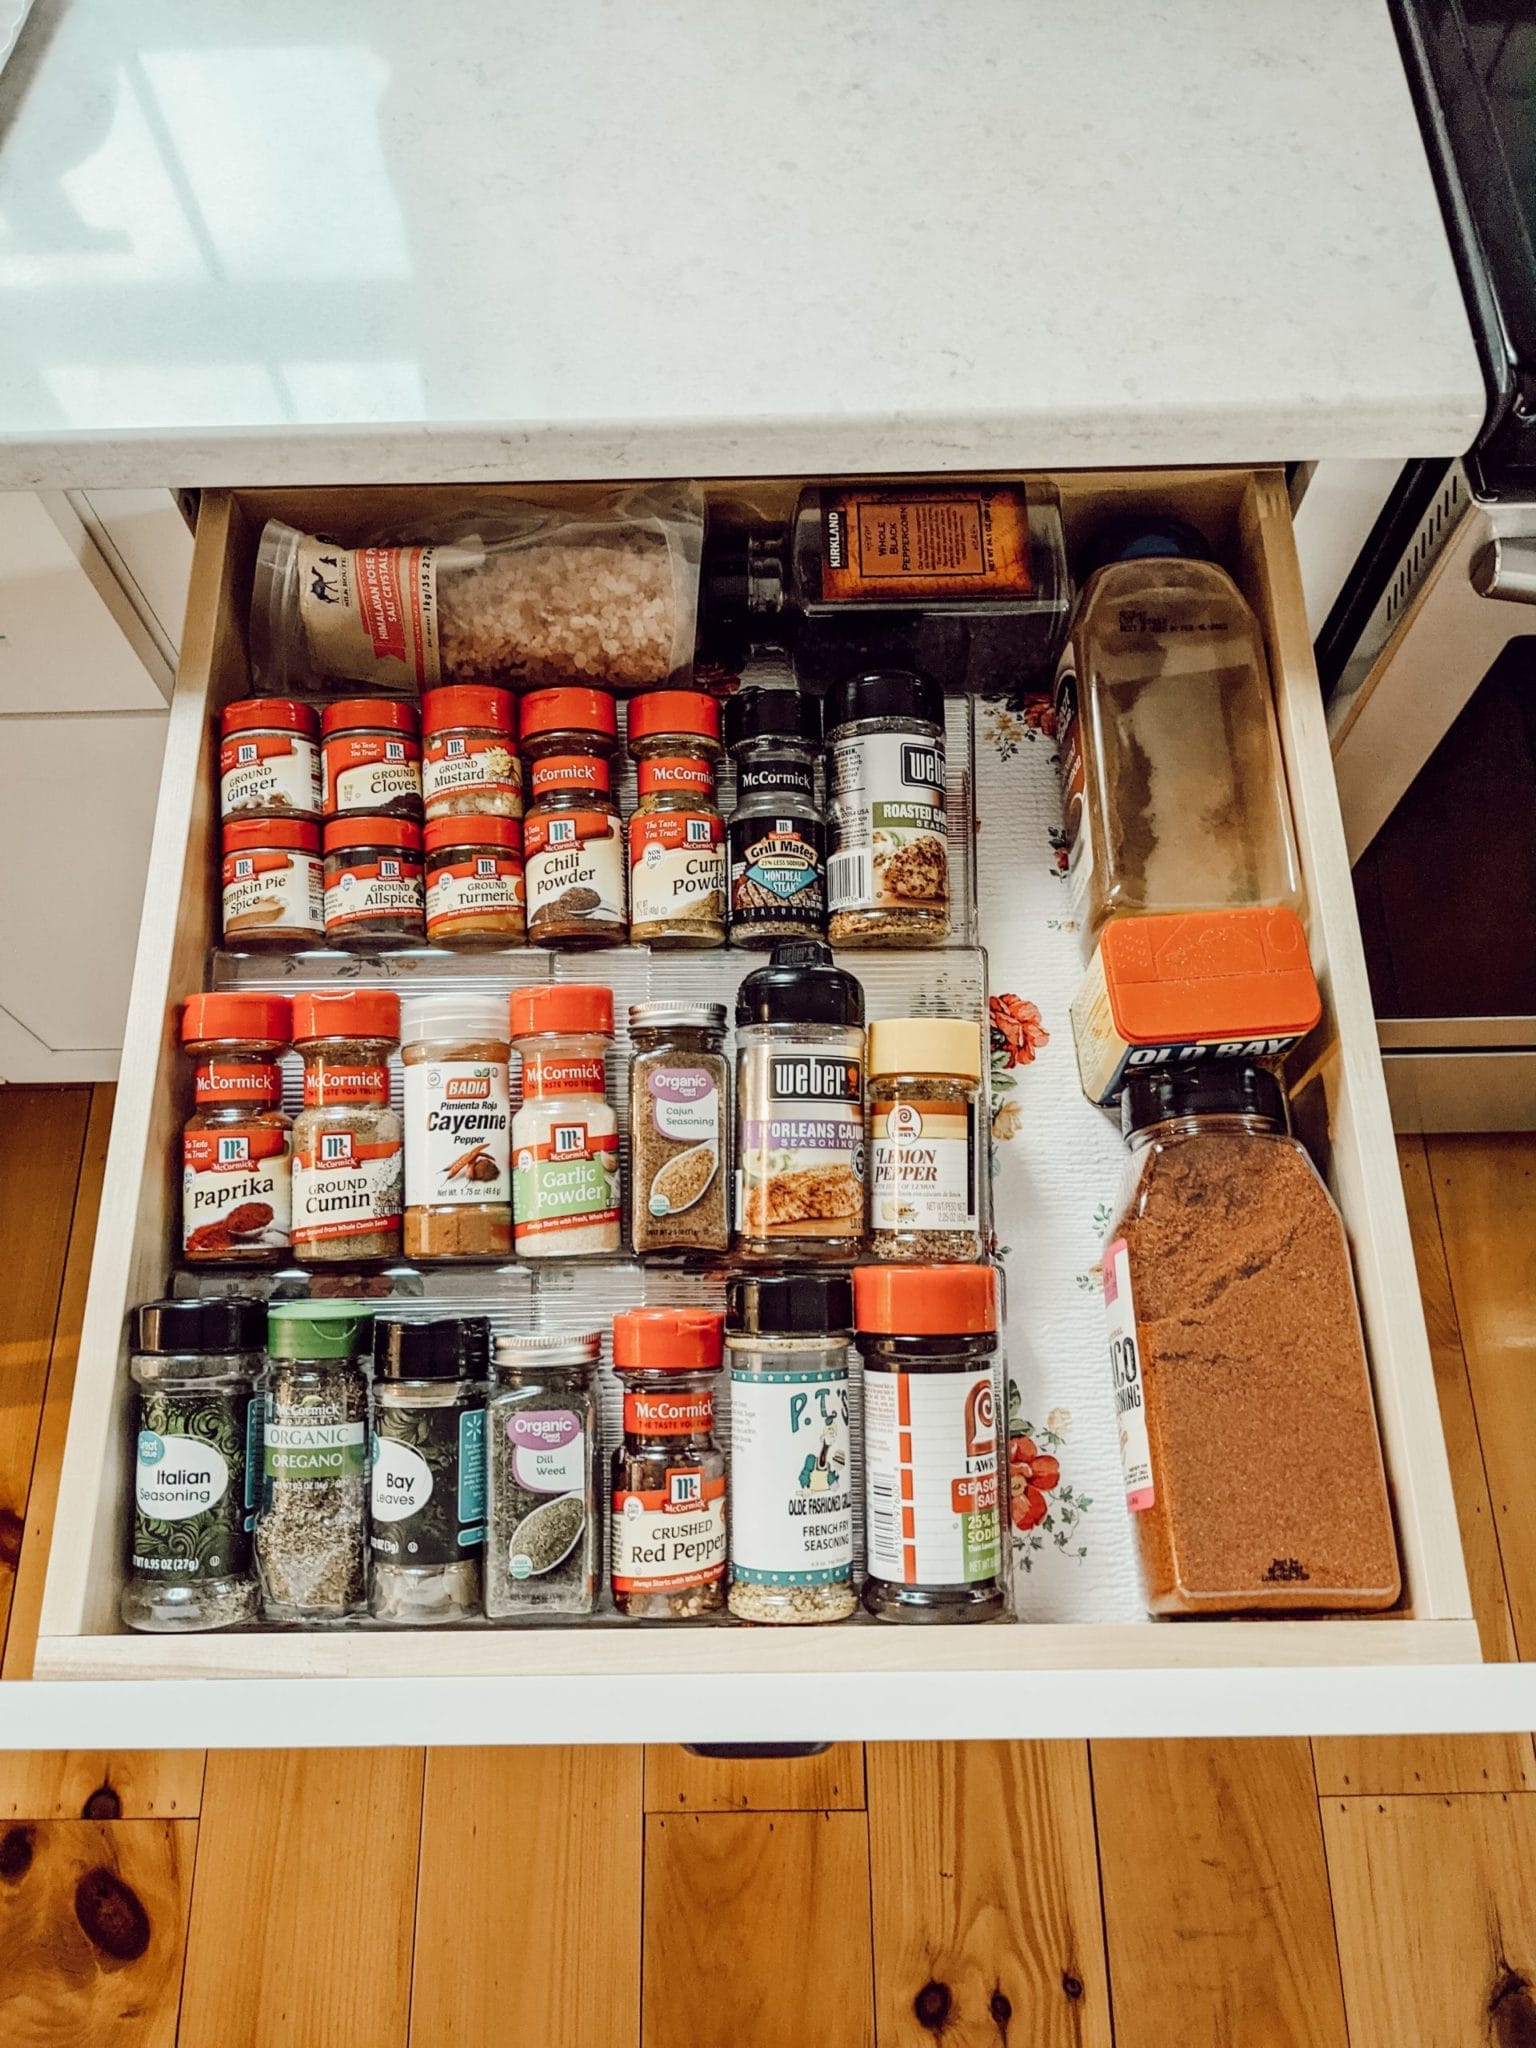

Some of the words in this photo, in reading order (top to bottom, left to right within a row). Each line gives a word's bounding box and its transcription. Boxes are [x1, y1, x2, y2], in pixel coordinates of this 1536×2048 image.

[828, 512, 841, 568] KIRKLAND
[877, 521, 887, 557] WHOLE
[888, 522, 898, 555] BLACK
[900, 507, 911, 571] PEPPERCORN
[366, 557, 378, 585] ROSE
[379, 551, 393, 598] CRYSTALS
[371, 586, 389, 640] HIMALAYAN
[385, 600, 398, 622] SALT
[372, 768, 415, 780] GROUND
[439, 760, 478, 774] GROUND
[653, 766, 714, 784] McCormic
[229, 767, 272, 788] GROUND
[433, 768, 485, 788] Mustard
[743, 771, 811, 789] McCormick
[227, 777, 278, 802] Ginger
[370, 780, 417, 793] Cloves
[883, 803, 932, 820] ROASTED
[645, 820, 657, 829] The
[645, 831, 657, 839] You
[751, 841, 776, 858] Grill
[780, 841, 815, 860] Mates
[544, 852, 580, 875] Chili
[686, 859, 725, 876] Curry
[537, 869, 596, 894] Powder
[764, 870, 802, 881] MONTREAL
[224, 881, 262, 906] umpkin
[265, 877, 286, 889] Pie
[370, 884, 410, 893] GROUND
[467, 881, 507, 891] GROUND
[672, 875, 726, 896] Powde
[773, 882, 795, 893] STEAK
[230, 895, 260, 914] Spice
[364, 893, 414, 906] Allspice
[458, 890, 514, 904] Turmeric
[1129, 1046, 1206, 1065] OLD
[1215, 1038, 1293, 1059] BAY
[306, 1072, 382, 1088] McCormick
[526, 1064, 600, 1082] McCormick
[197, 1074, 272, 1090] McCormick
[449, 1080, 487, 1095] BADIA
[655, 1074, 707, 1090] Organic
[440, 1101, 479, 1111] Pimienta
[482, 1101, 497, 1111] Roja
[666, 1107, 693, 1116] Cajun
[427, 1112, 506, 1134] Cayenne
[666, 1117, 714, 1126] Seasoning
[759, 1122, 834, 1138] 'ORLEANS
[454, 1135, 485, 1145] Pepper
[780, 1139, 853, 1148] SEASONING
[876, 1147, 936, 1165] LEMON
[543, 1166, 596, 1188] Garlic
[875, 1166, 937, 1183] PEPPER
[194, 1177, 274, 1209] Paprika
[308, 1178, 367, 1195] GROUND
[306, 1190, 370, 1214] Cumin
[537, 1185, 603, 1208] Powder
[1110, 1336, 1137, 1389] CO
[635, 1399, 712, 1419] McCormick
[515, 1417, 572, 1436] Organic
[654, 1421, 677, 1429] TASTE
[270, 1428, 349, 1445] ORGANIC
[272, 1453, 343, 1468] OREGANO
[536, 1455, 553, 1464] Dill
[156, 1469, 211, 1485] Italian
[536, 1466, 566, 1475] Weed
[386, 1473, 415, 1492] Bay
[140, 1487, 211, 1503] Seasoning
[376, 1491, 415, 1505] Leaves
[977, 1490, 997, 1507] SALT
[789, 1499, 807, 1516] OLDE
[808, 1495, 841, 1515] FASHIONED
[652, 1519, 713, 1540] CRUSHED
[803, 1522, 838, 1537] FRENCH
[839, 1520, 849, 1532] FRY
[968, 1513, 991, 1529] 25%
[632, 1544, 665, 1563] Red
[673, 1533, 724, 1562] Pepper
[144, 1558, 160, 1570] 0.95
[162, 1558, 172, 1570] OZ
[173, 1557, 199, 1571] (27g)
